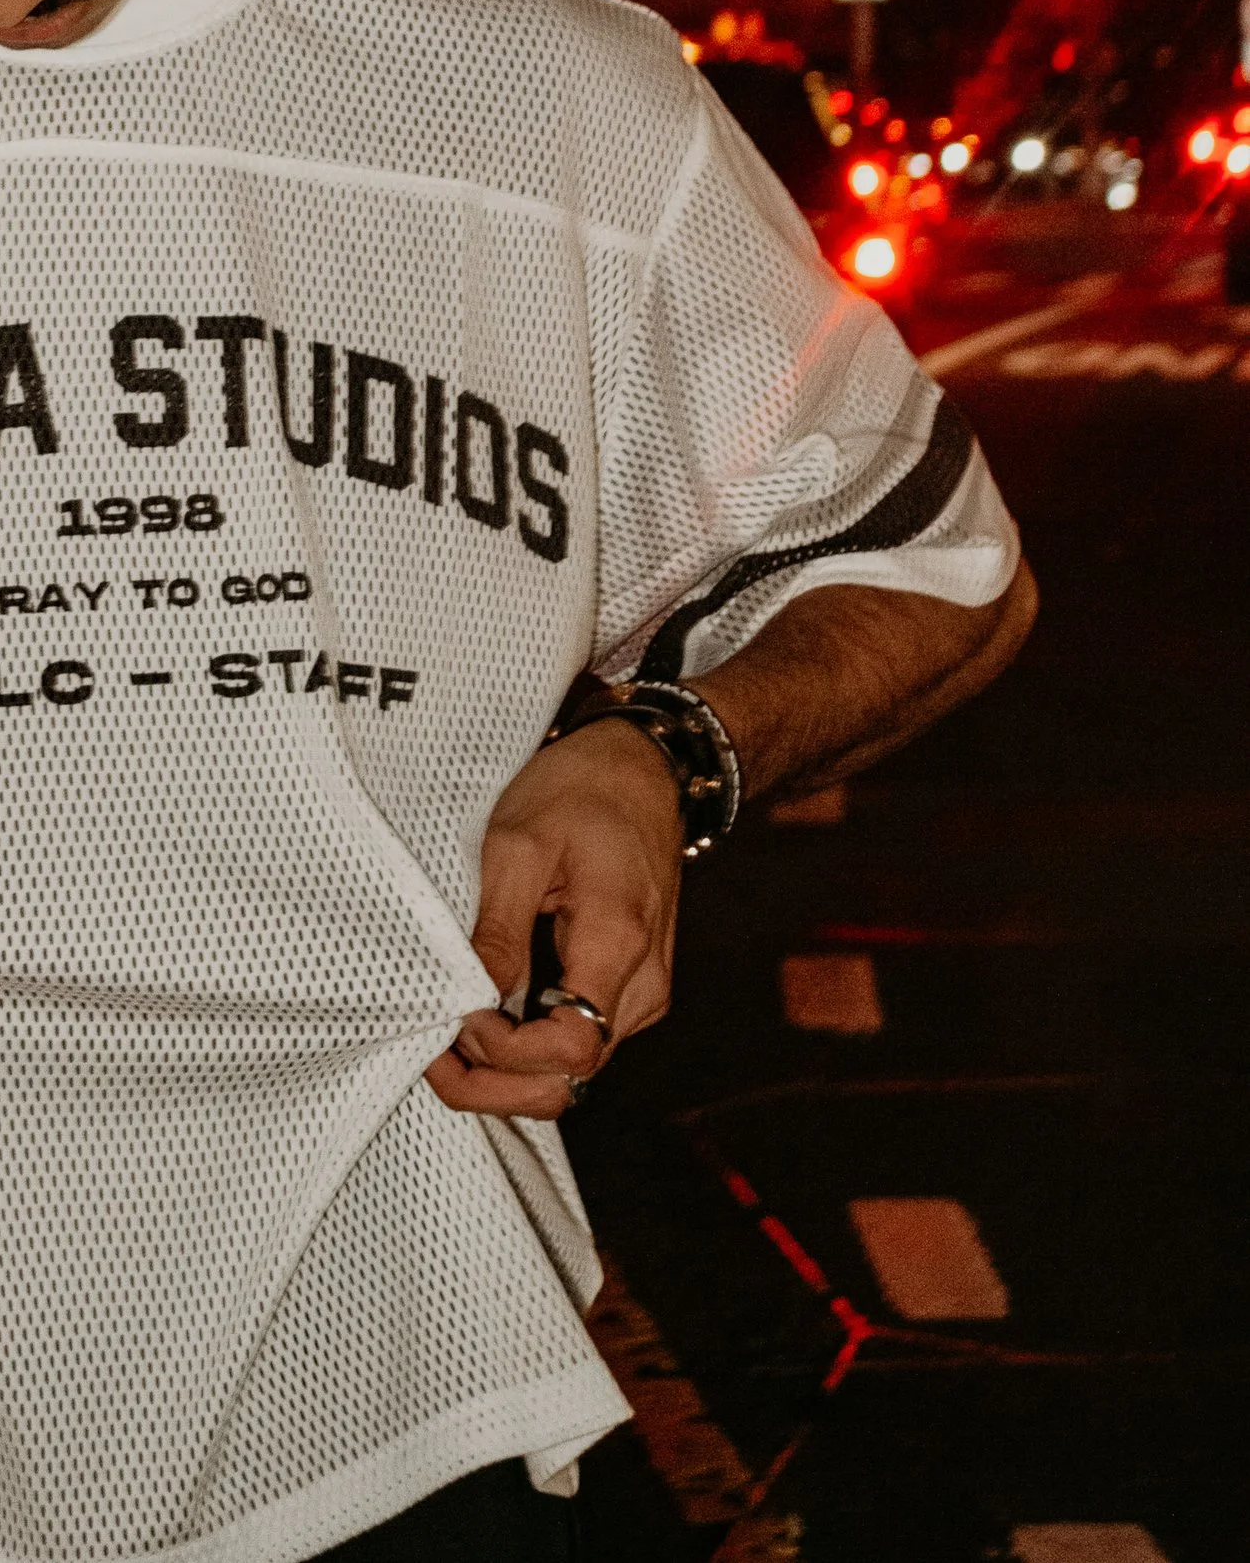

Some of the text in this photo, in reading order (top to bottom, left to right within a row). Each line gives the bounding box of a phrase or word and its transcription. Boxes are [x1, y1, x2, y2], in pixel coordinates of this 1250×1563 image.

[108, 314, 570, 564] STUDIOS
[56, 493, 226, 537] 1998
[132, 576, 190, 610] TO
[220, 571, 312, 606] GOD
[209, 649, 420, 712] STAFF
